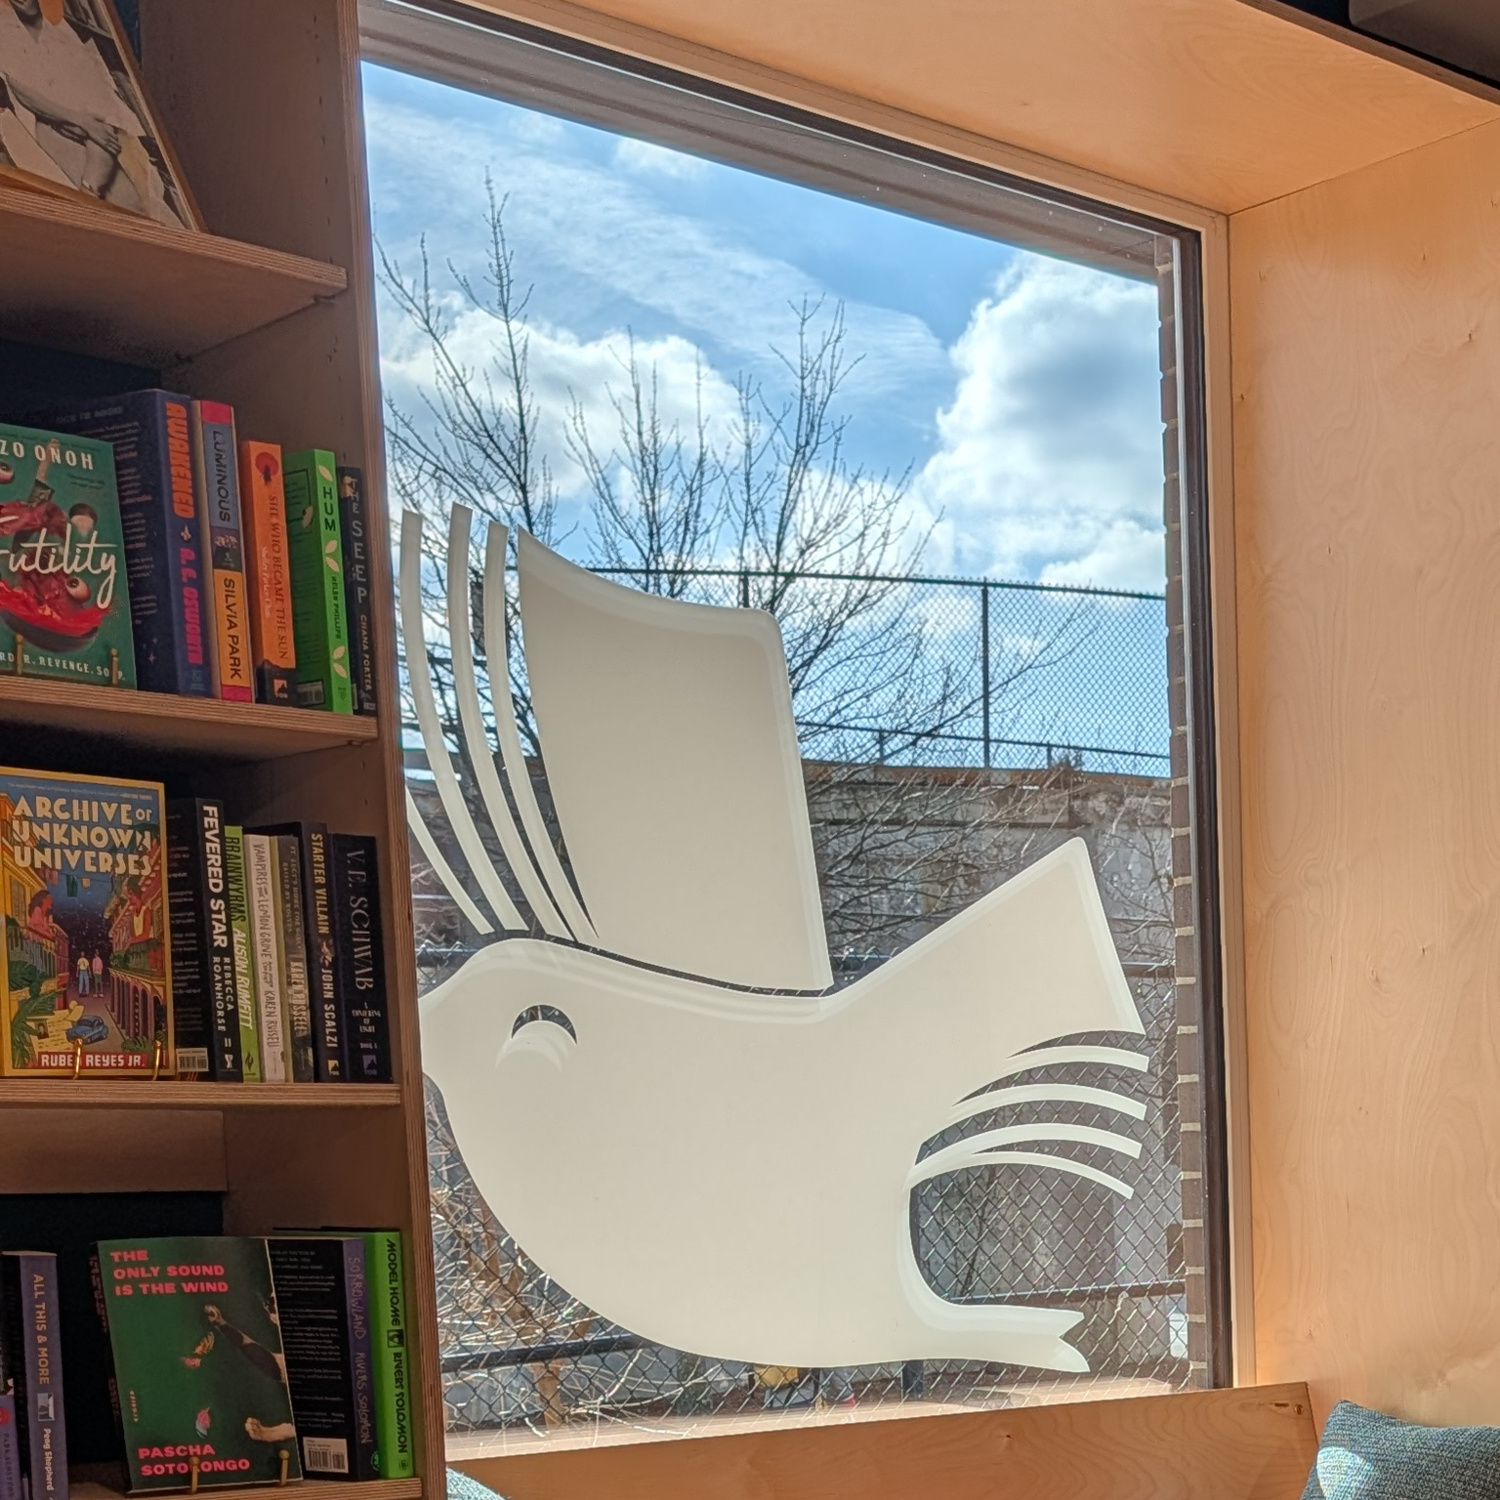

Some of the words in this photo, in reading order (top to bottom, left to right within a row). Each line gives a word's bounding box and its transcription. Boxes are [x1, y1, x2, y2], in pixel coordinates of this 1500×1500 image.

[35, 446, 94, 470] ONOH
[165, 403, 194, 519] AWAKENED
[212, 430, 231, 522] LUMINOUS
[322, 486, 336, 532] HUM
[0, 522, 118, 608] utility
[351, 521, 366, 604] SEEP
[223, 577, 240, 629] SILVIA
[227, 633, 243, 680] PARK
[13, 796, 133, 825] ARCHIVE
[13, 820, 151, 849] UNKNOWN
[203, 805, 224, 895] FEVERED
[14, 845, 151, 875] UNIVERSES
[225, 837, 246, 922] BRAINWYRMS
[311, 833, 325, 886] STARTER
[210, 898, 227, 947] STAR
[314, 889, 329, 934] VILLAIN
[234, 928, 247, 972] ALISON
[350, 897, 373, 990] SCHWAB
[213, 957, 226, 1032] ROANHORSE
[223, 957, 233, 1011] REBECCA
[322, 968, 334, 1001] JOHN
[323, 1004, 338, 1048] SCALZI
[85, 1054, 125, 1067] REYES
[127, 1054, 145, 1067] JR.
[110, 1250, 148, 1263] THE
[113, 1266, 161, 1279] ONLY
[167, 1264, 225, 1277] SOUND
[386, 1238, 398, 1281] MODEL
[33, 1274, 43, 1297] ALL
[116, 1284, 135, 1296] IS
[141, 1283, 178, 1295] THE
[181, 1282, 229, 1293] WIND
[348, 1257, 365, 1340] SORROWLAND
[387, 1284, 401, 1326] HOME
[34, 1301, 46, 1331] THIS
[38, 1335, 47, 1344] &
[38, 1348, 50, 1385] MORE
[43, 1429, 52, 1449] Peng
[138, 1444, 215, 1459] PASCHA
[44, 1450, 55, 1490] Shepherd
[141, 1459, 250, 1475] SOTOONGO
